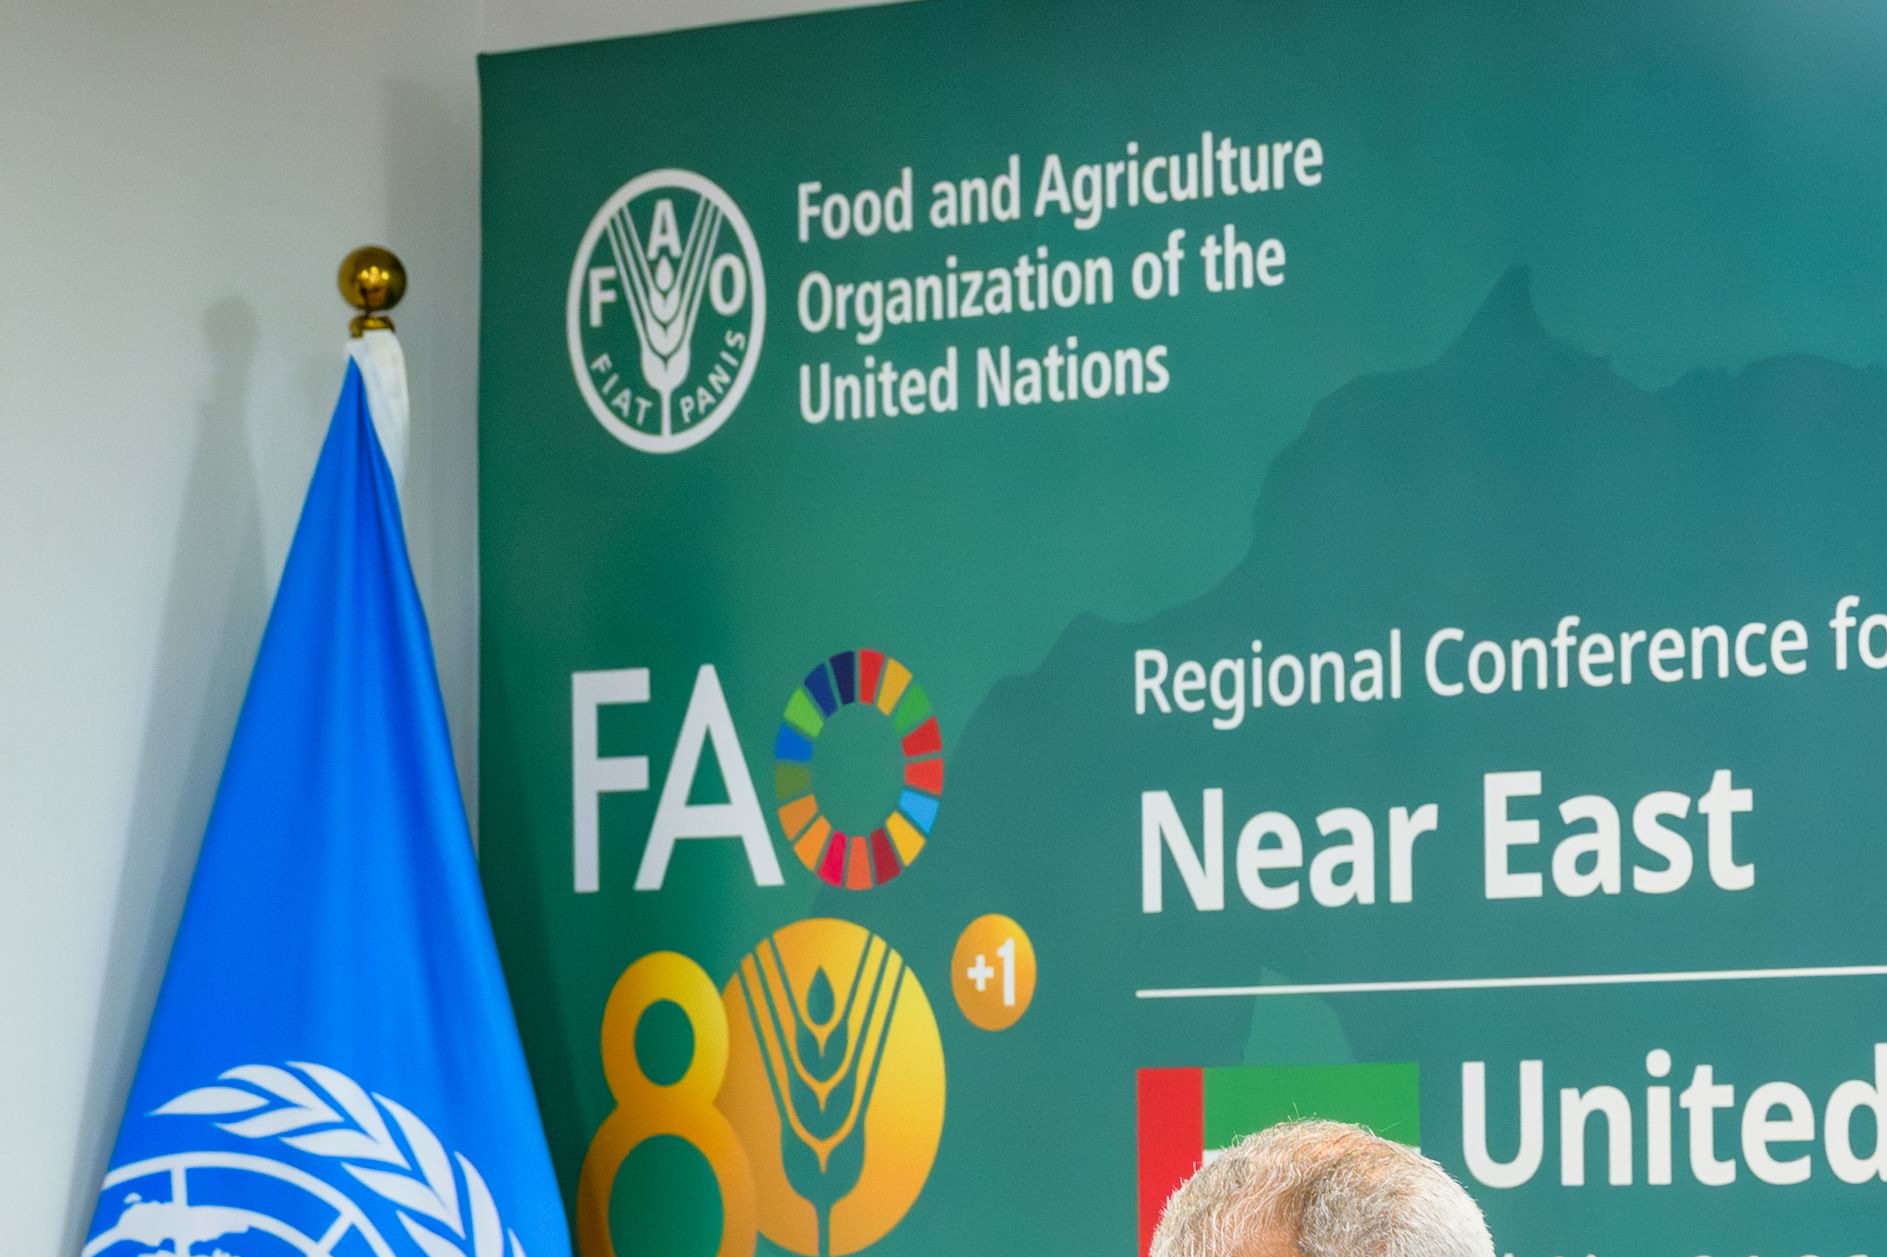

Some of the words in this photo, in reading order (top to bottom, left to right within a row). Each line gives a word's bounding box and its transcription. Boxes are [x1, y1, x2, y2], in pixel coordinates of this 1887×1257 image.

[799, 167, 912, 242] Food
[930, 154, 1020, 228] and
[1035, 131, 1323, 230] Agriculture
[798, 246, 1113, 349] Organization
[1132, 229, 1185, 300] of
[1200, 224, 1285, 294] the
[591, 353, 652, 425] FIAT
[680, 330, 745, 422] PANIS
[800, 346, 958, 423] United
[976, 337, 1169, 409] Nations
[1135, 629, 1401, 730] Regional
[1425, 616, 1808, 697] Conference
[1142, 788, 1438, 913] Near
[1484, 769, 1755, 900] East
[967, 937, 1016, 1007] +1
